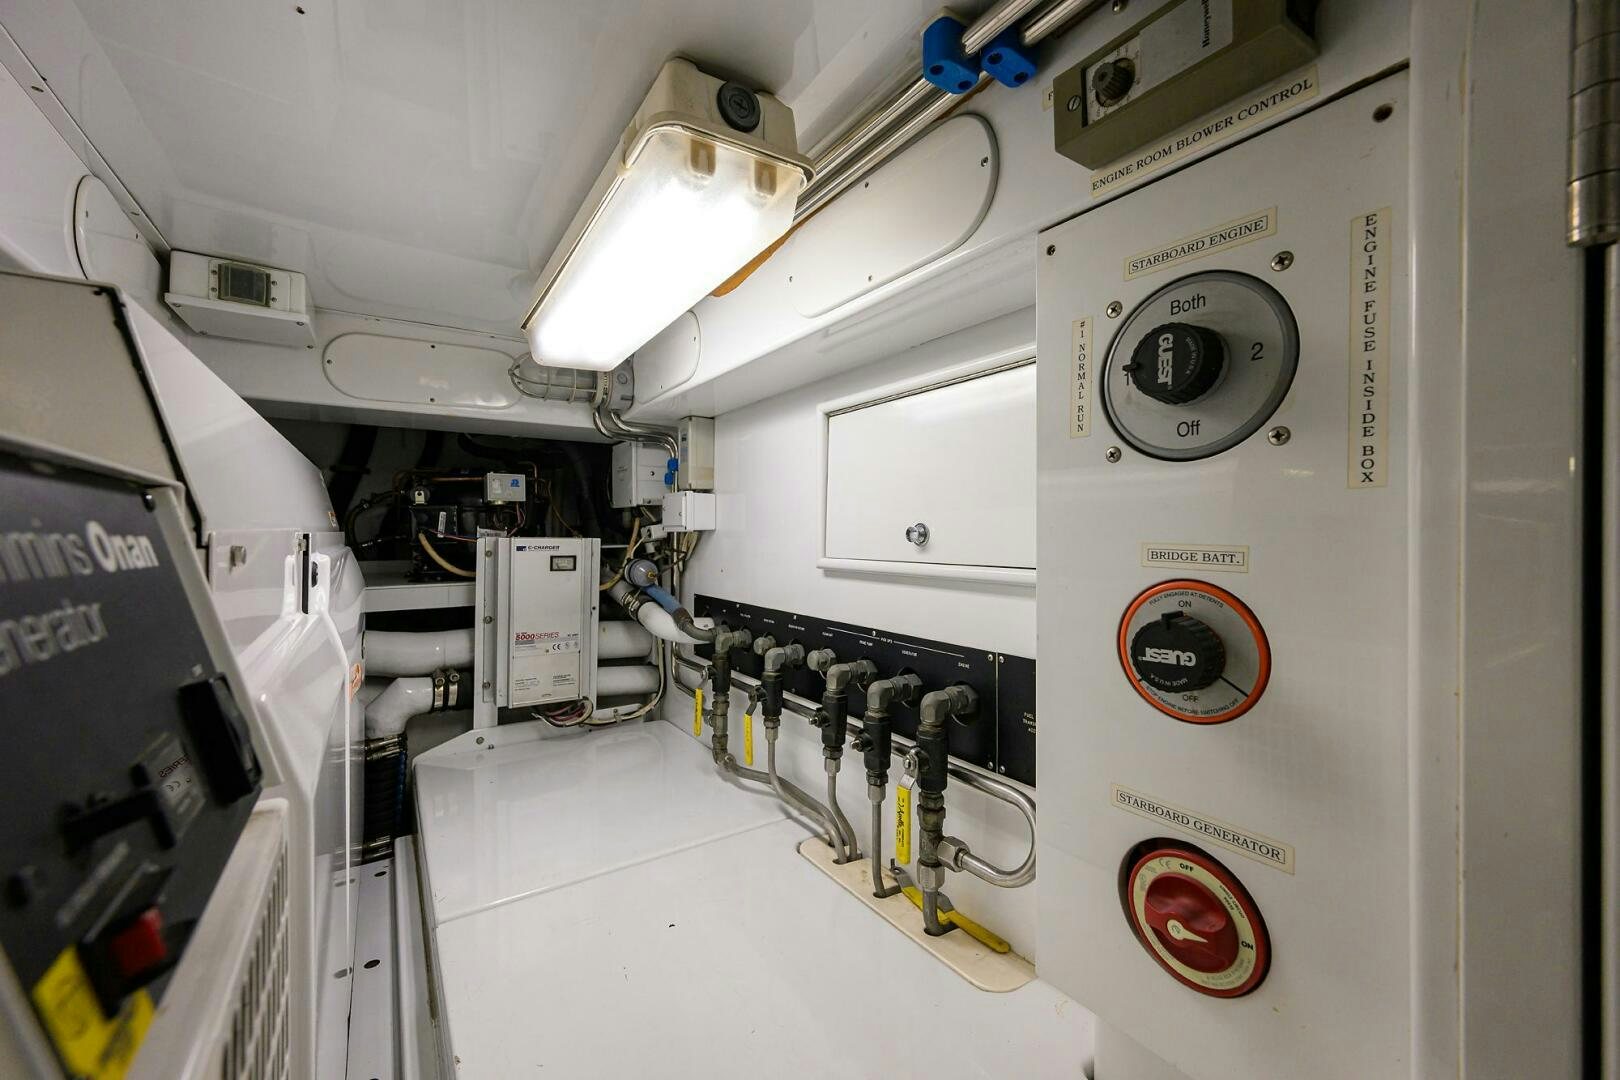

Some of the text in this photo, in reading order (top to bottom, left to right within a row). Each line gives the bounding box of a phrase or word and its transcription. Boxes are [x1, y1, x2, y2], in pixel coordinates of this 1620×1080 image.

[1092, 78, 1313, 191] ENGINE ROOM BLOWER CONTROL
[1131, 220, 1263, 272] STARBOARD ENGINE
[1170, 293, 1206, 316] Both
[1250, 342, 1264, 361] 2
[1361, 213, 1378, 482] ENGINE FUSE INSIDE BOX
[1077, 343, 1086, 399] NORMAL
[1077, 405, 1085, 432] RUN
[1176, 420, 1201, 438] Off
[86, 520, 159, 573] Onan
[1151, 551, 1240, 564] BRIDGE BATT.
[1178, 600, 1192, 608] ON
[1145, 647, 1196, 667] GUEST
[1182, 693, 1199, 703] OFF
[1119, 793, 1281, 860] STARBOARD GENERATOR
[1179, 863, 1194, 873] OFF
[1241, 940, 1254, 951] ON
